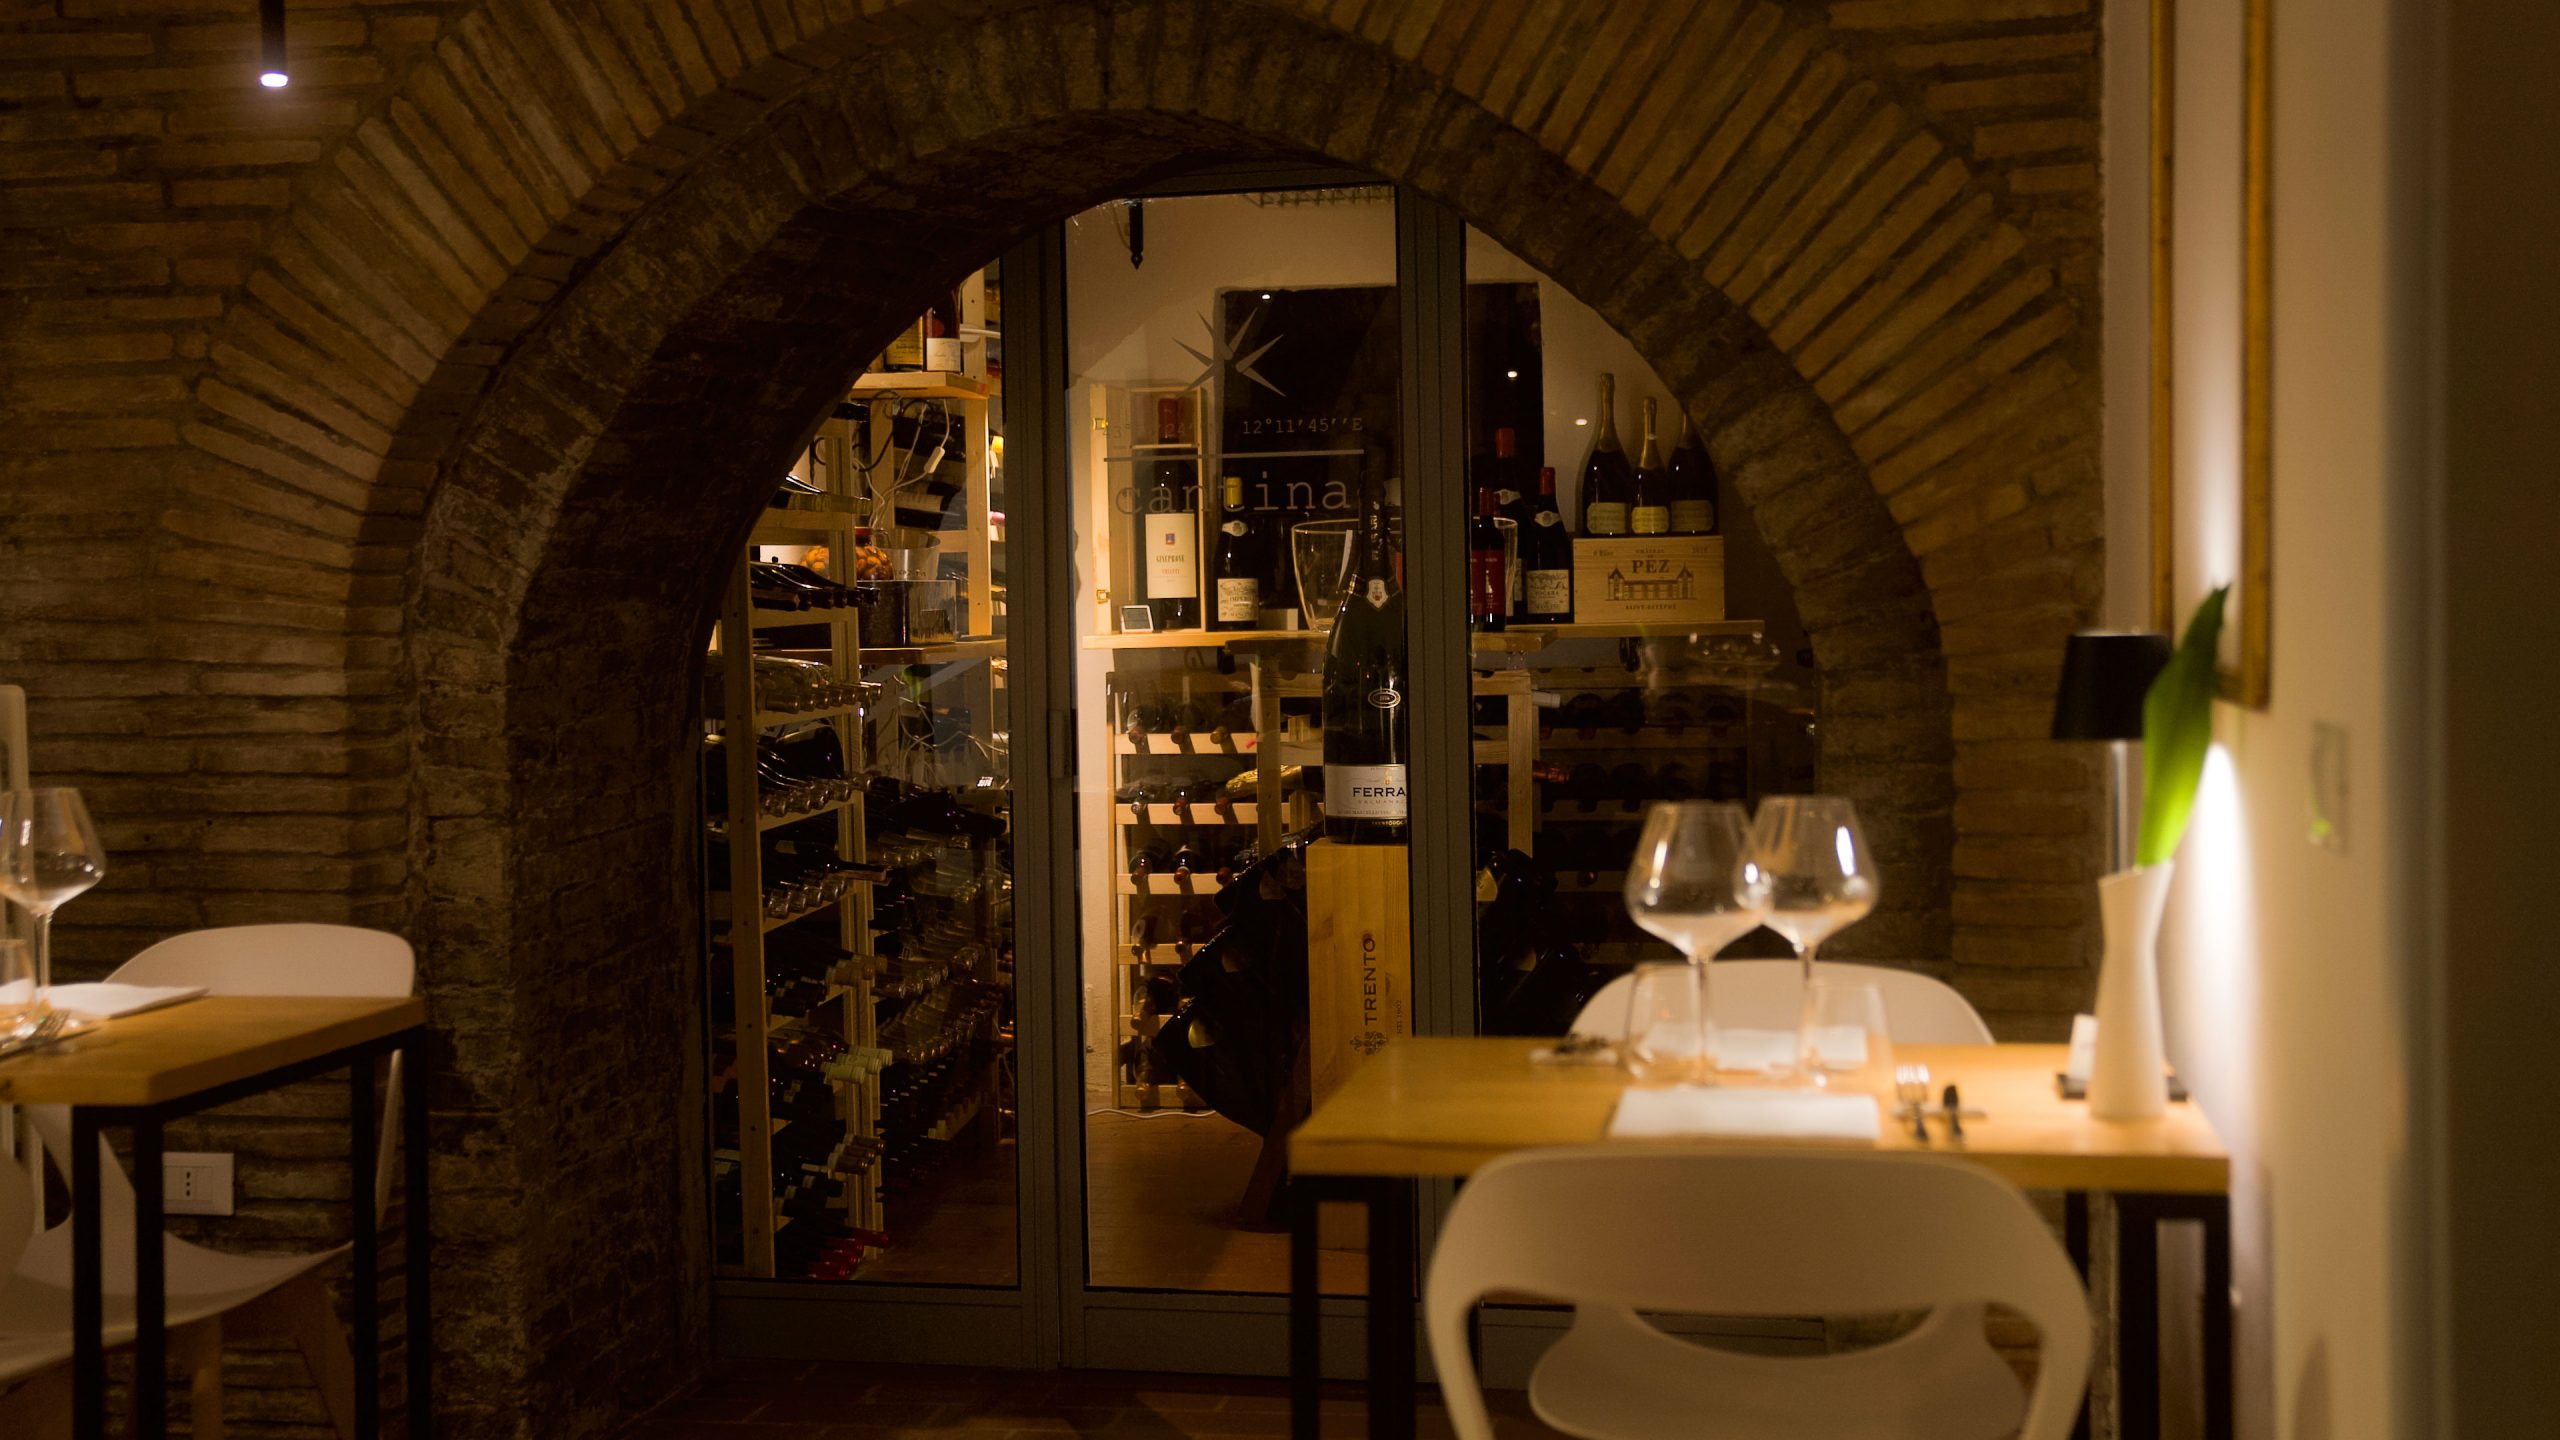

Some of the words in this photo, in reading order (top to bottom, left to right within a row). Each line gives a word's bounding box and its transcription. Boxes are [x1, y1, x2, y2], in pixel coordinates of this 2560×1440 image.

[1115, 471, 1353, 514] cantina
[1632, 559, 1670, 574] PEZ
[1352, 786, 1406, 798] FERRA
[1363, 937, 1377, 1026] TRENTO
